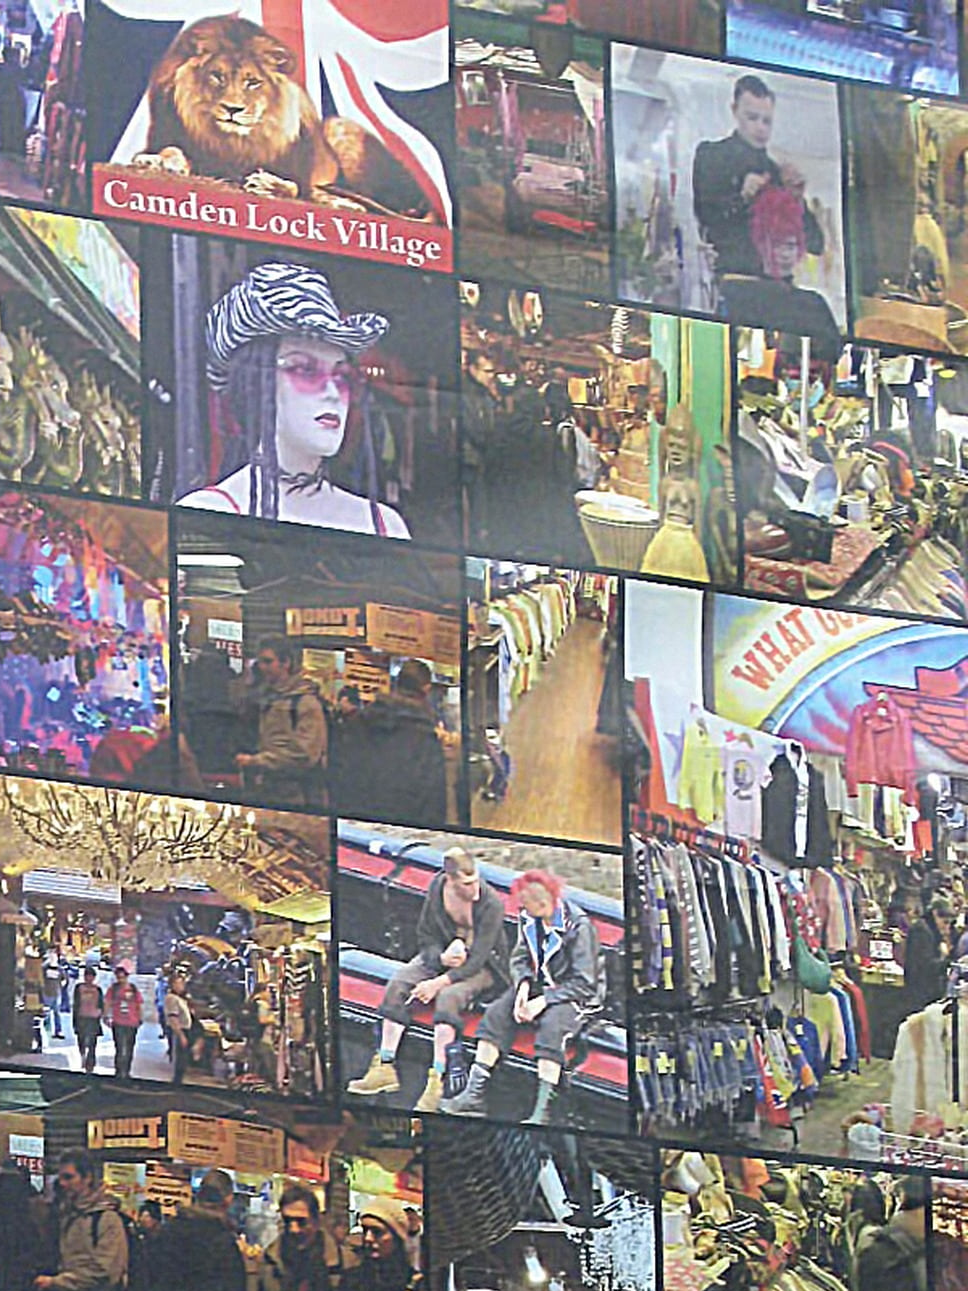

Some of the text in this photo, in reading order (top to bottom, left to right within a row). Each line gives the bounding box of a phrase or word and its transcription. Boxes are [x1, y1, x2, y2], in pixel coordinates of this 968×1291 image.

[103, 179, 443, 268] Camden Lock Village
[730, 606, 816, 692] WHAT
